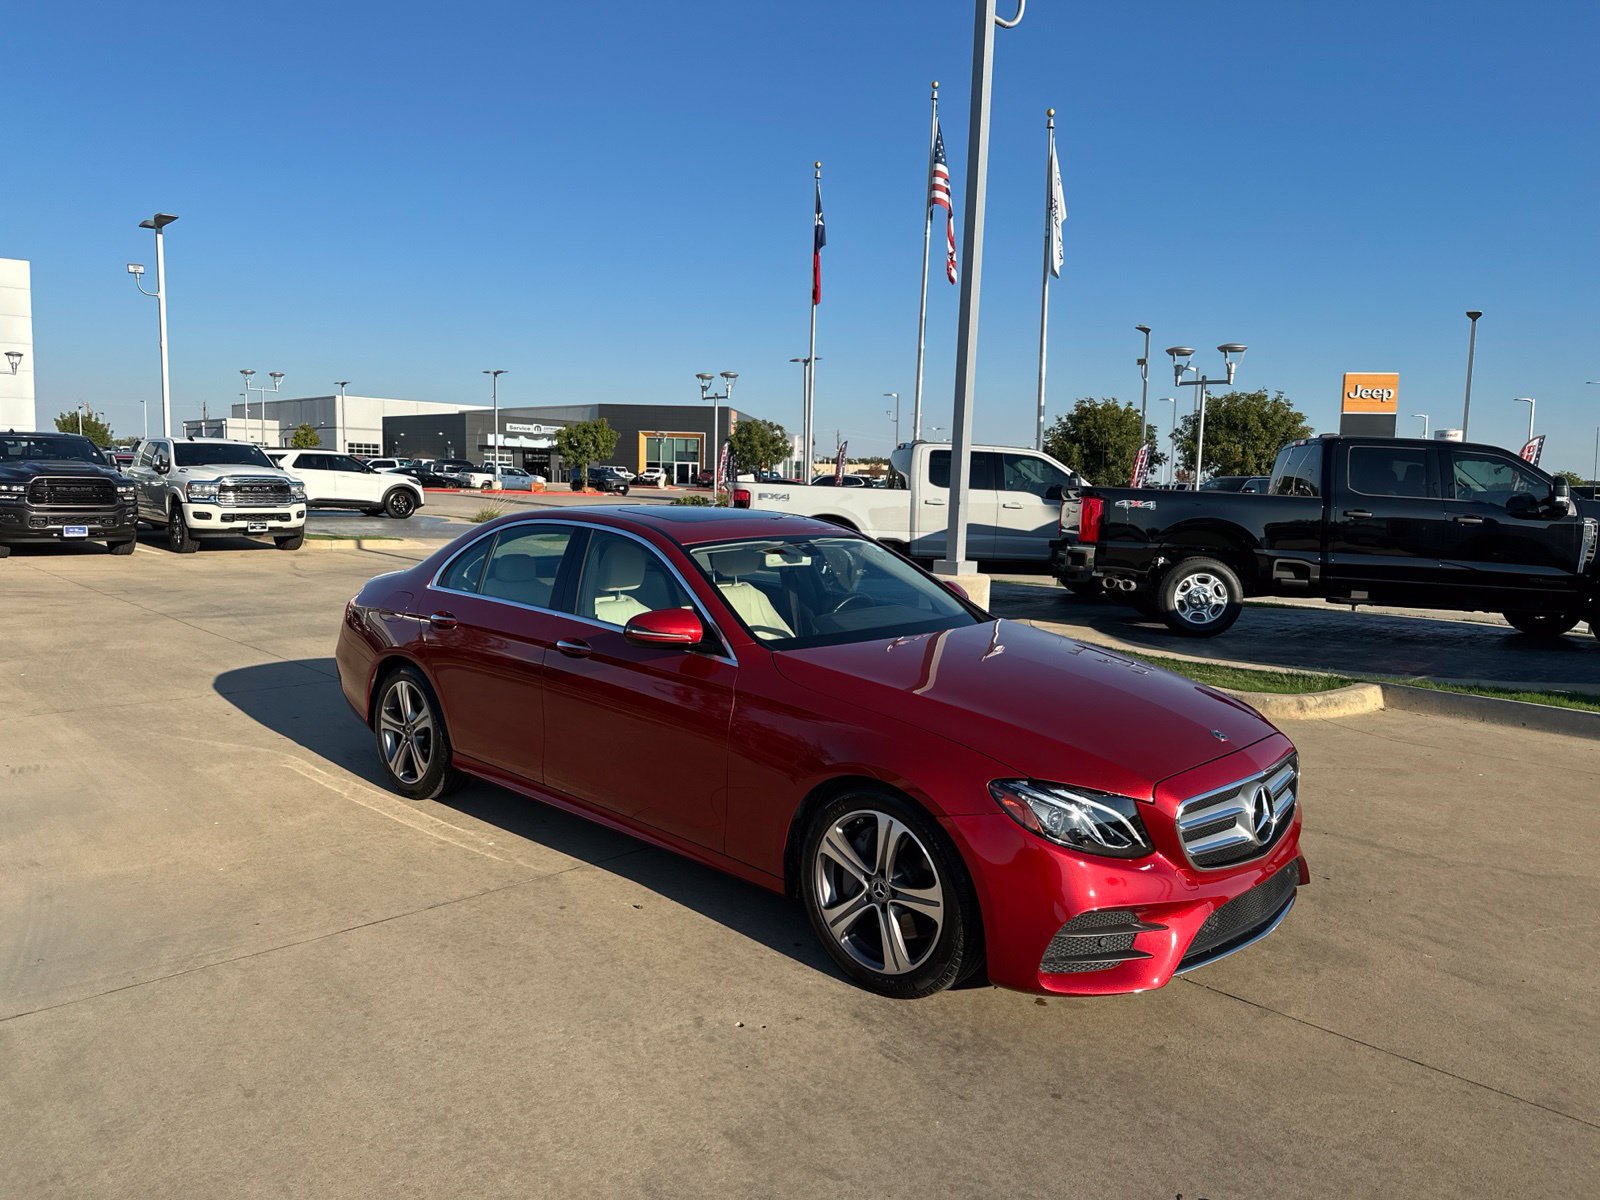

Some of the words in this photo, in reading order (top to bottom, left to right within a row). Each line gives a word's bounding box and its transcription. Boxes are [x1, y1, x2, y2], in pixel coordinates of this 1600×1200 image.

[1347, 384, 1395, 403] Jeep
[509, 424, 531, 432] Service
[758, 492, 790, 501] FX4
